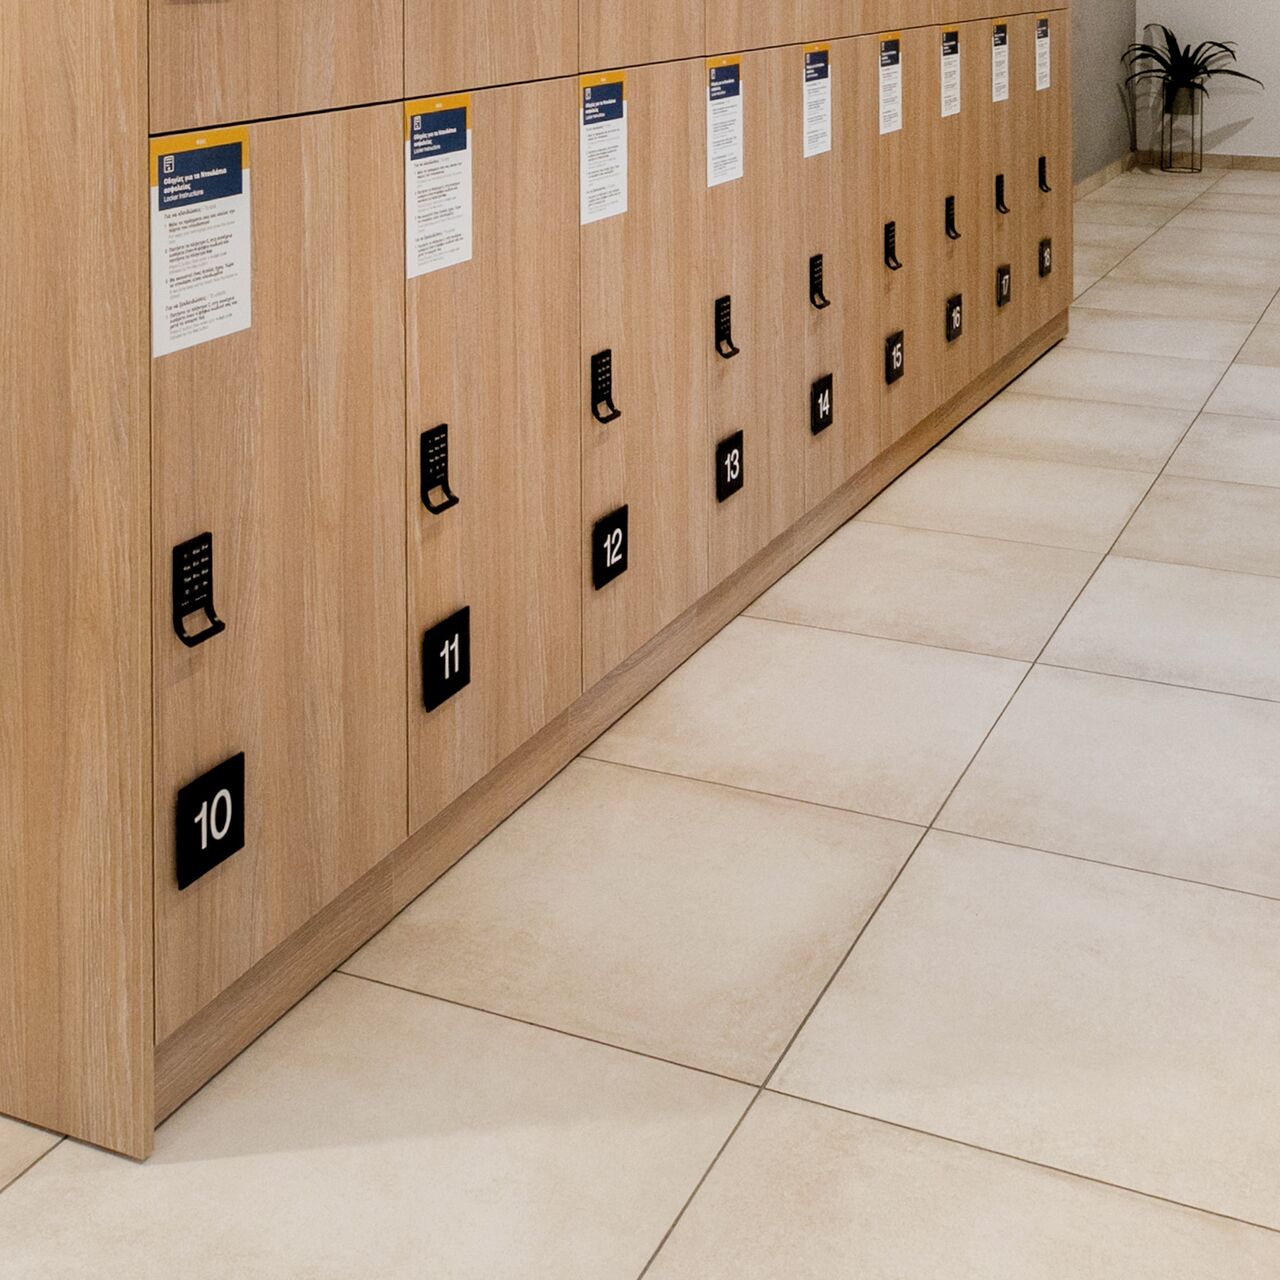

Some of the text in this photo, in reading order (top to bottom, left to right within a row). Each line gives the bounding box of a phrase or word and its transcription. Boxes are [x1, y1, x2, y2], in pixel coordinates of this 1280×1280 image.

[1001, 274, 1009, 295] 17
[951, 306, 961, 329] 16
[891, 343, 902, 369] 15
[818, 389, 830, 419] 14
[724, 448, 740, 482] 13
[603, 527, 623, 568] 12
[439, 633, 459, 679] 11
[194, 788, 232, 850] 10
